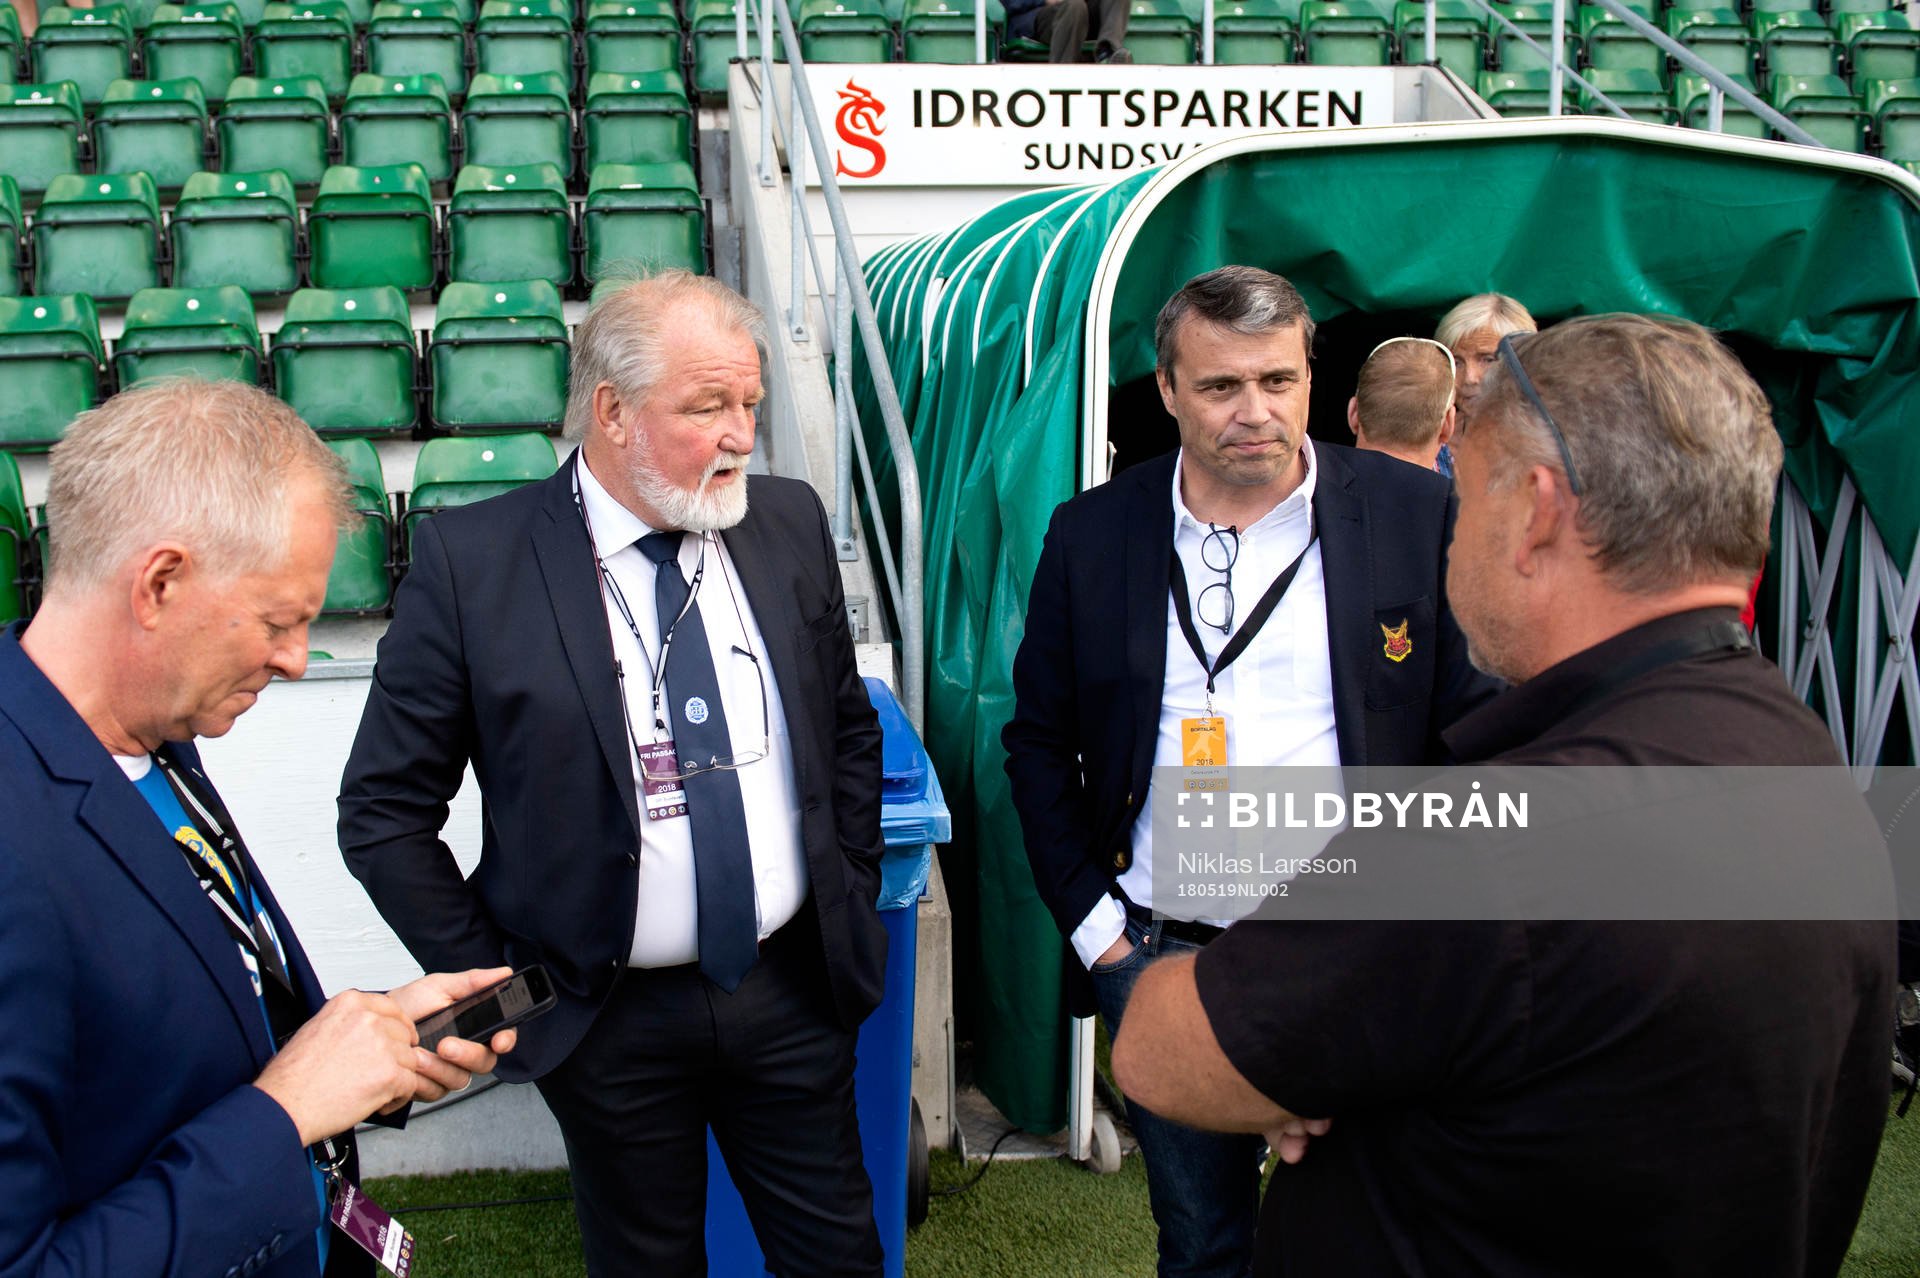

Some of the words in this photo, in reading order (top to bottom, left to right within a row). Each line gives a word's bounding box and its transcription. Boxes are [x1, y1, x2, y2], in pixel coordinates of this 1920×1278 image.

[913, 89, 1363, 128] IDROTTSPARKEN
[1024, 143, 1203, 170] SUNDSV
[658, 784, 676, 793] 2018
